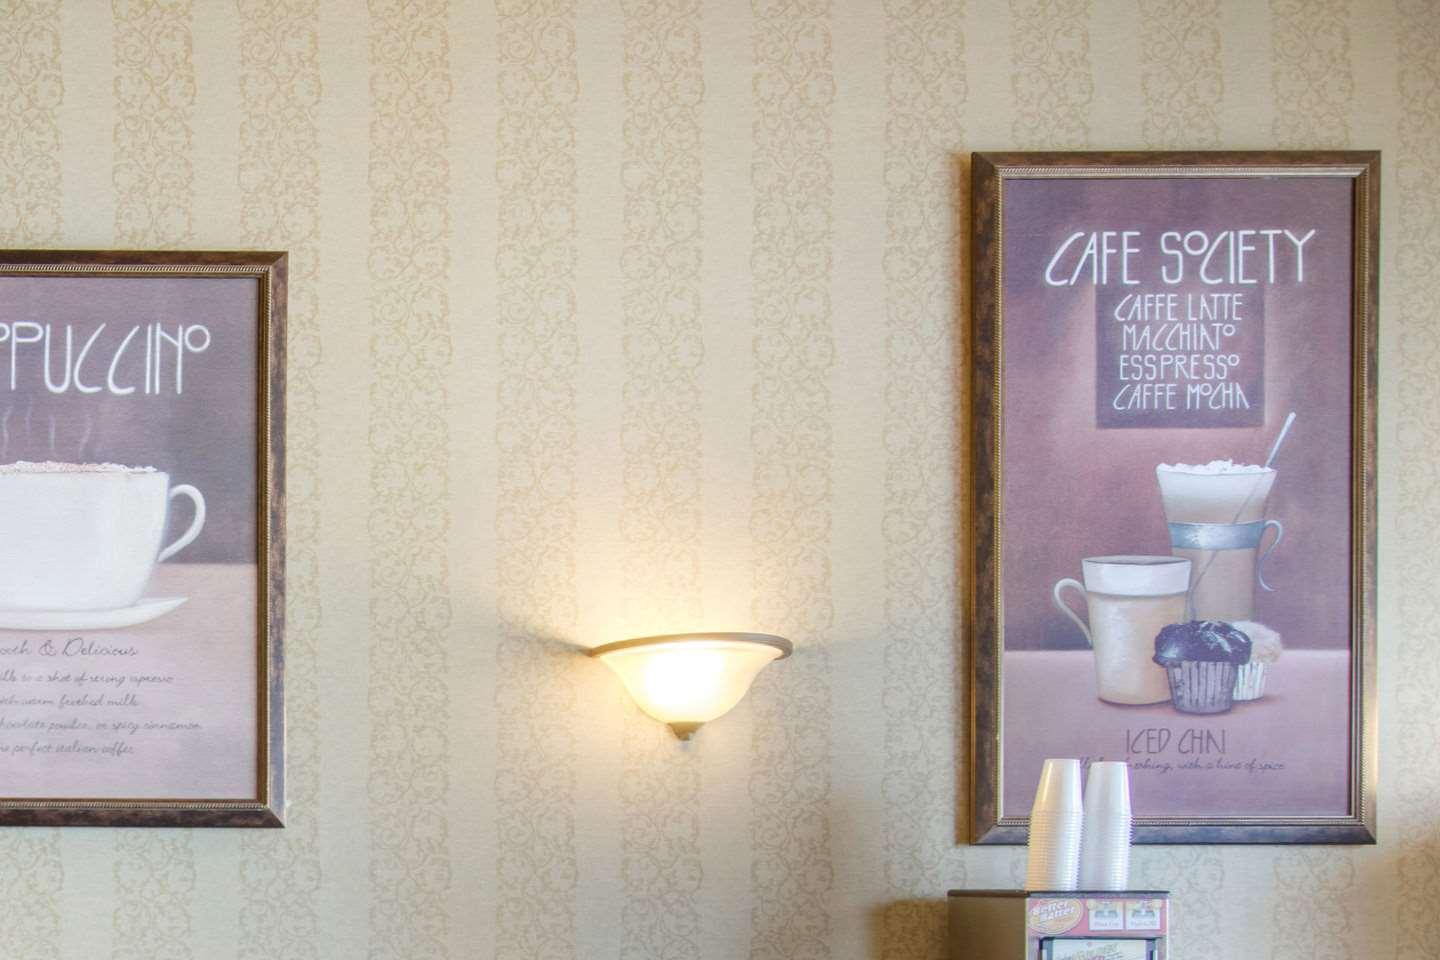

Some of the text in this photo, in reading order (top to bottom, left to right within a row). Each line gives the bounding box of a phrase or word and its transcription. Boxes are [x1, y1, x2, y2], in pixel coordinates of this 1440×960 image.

[1045, 229, 1316, 286] CAFE SOCIETY
[1114, 294, 1243, 321] CAFFE LATTE
[1119, 354, 1240, 381] ESSPRESSO
[1113, 382, 1250, 410] CAFFE MOCHA
[39, 639, 57, 656] &
[62, 637, 138, 656] Delicious
[1125, 727, 1226, 754] ICED CHAI
